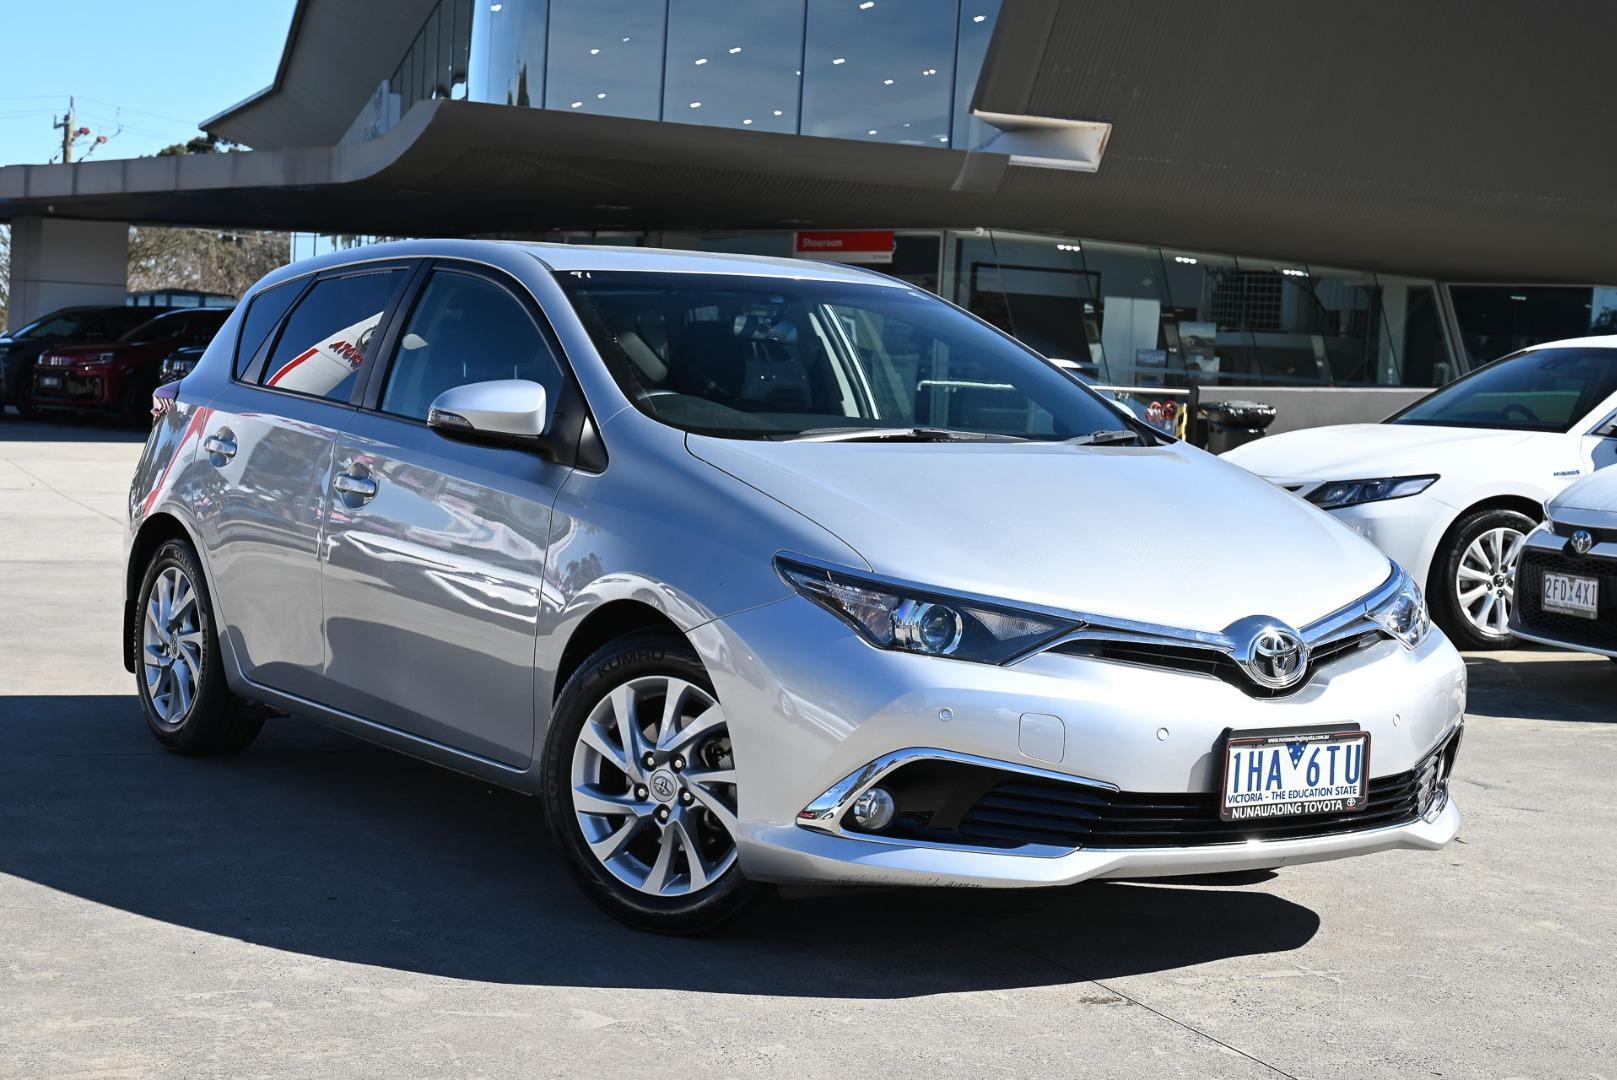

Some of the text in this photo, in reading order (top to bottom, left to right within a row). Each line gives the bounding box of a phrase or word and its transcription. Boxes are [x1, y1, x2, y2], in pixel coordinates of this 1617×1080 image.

[802, 238, 843, 247] Showroom
[1545, 577, 1567, 601] 2FD
[596, 648, 665, 678] KUMHO
[1233, 744, 1361, 793] 1HA 6TU
[1227, 792, 1263, 804] VICTORIA
[1271, 791, 1286, 800] THE
[1288, 788, 1331, 799] EDUCATION
[1334, 785, 1357, 796] STATE
[1231, 799, 1343, 819] NUNAWADING TOYOTA
